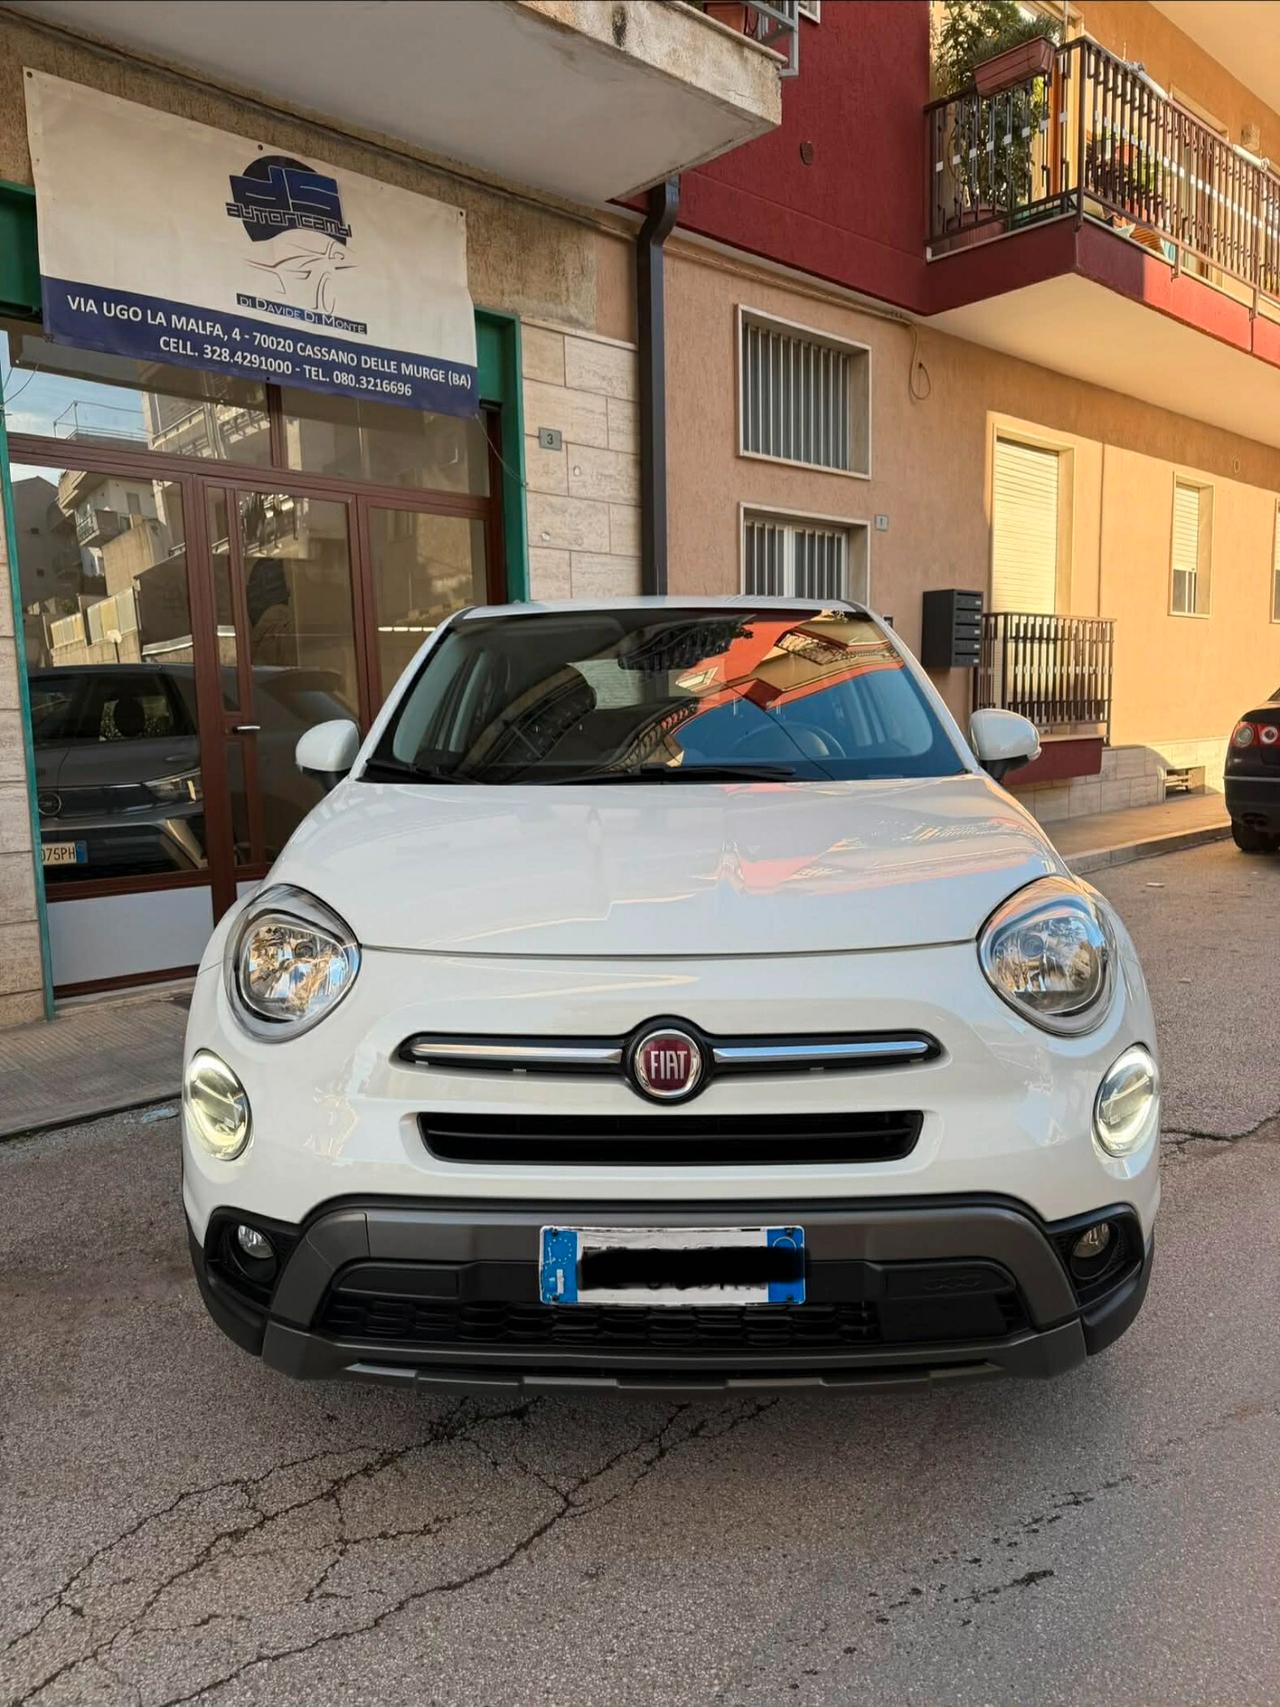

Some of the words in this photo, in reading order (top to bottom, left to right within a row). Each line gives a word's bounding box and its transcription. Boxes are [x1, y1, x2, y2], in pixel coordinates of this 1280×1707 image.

[66, 294, 98, 315] VIA
[103, 301, 142, 322] UGO
[147, 309, 167, 327] LA
[171, 314, 228, 342] MALFA,
[231, 327, 241, 342] 4
[252, 331, 294, 353] 70020
[297, 342, 357, 366] CASSANO
[361, 355, 398, 374] DELLE
[401, 362, 446, 383] MURGE
[448, 370, 472, 390] (BA)
[159, 336, 199, 357] CELL.
[203, 344, 292, 375] 328.4291000
[302, 364, 330, 382] TEL.
[333, 370, 413, 396] 080.3216696
[546, 433, 554, 446] 3
[650, 1050, 688, 1080] FIAT
